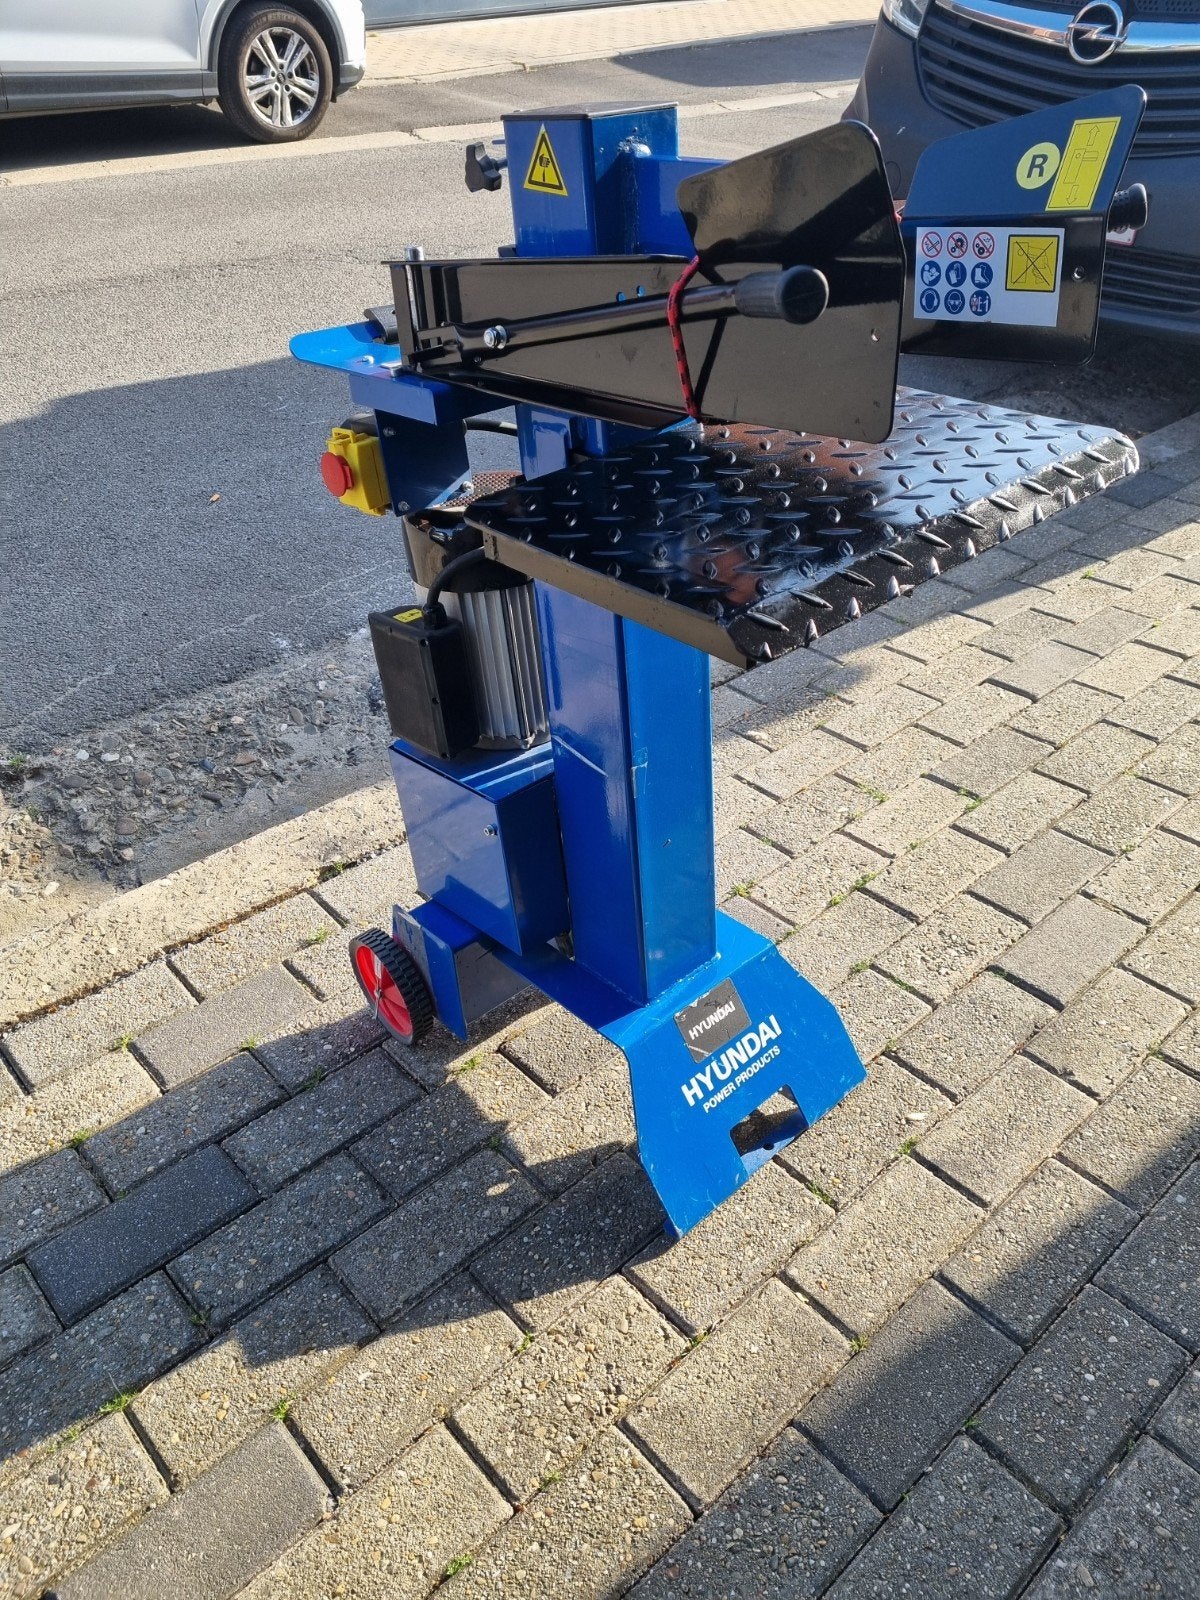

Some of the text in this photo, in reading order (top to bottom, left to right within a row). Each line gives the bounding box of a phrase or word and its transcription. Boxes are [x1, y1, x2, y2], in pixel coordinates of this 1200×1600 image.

[1026, 153, 1049, 178] R
[688, 1000, 736, 1040] HYUNDAI
[681, 1014, 782, 1107] HYUNDAI
[703, 1045, 781, 1113] POWER PRODUCTS
